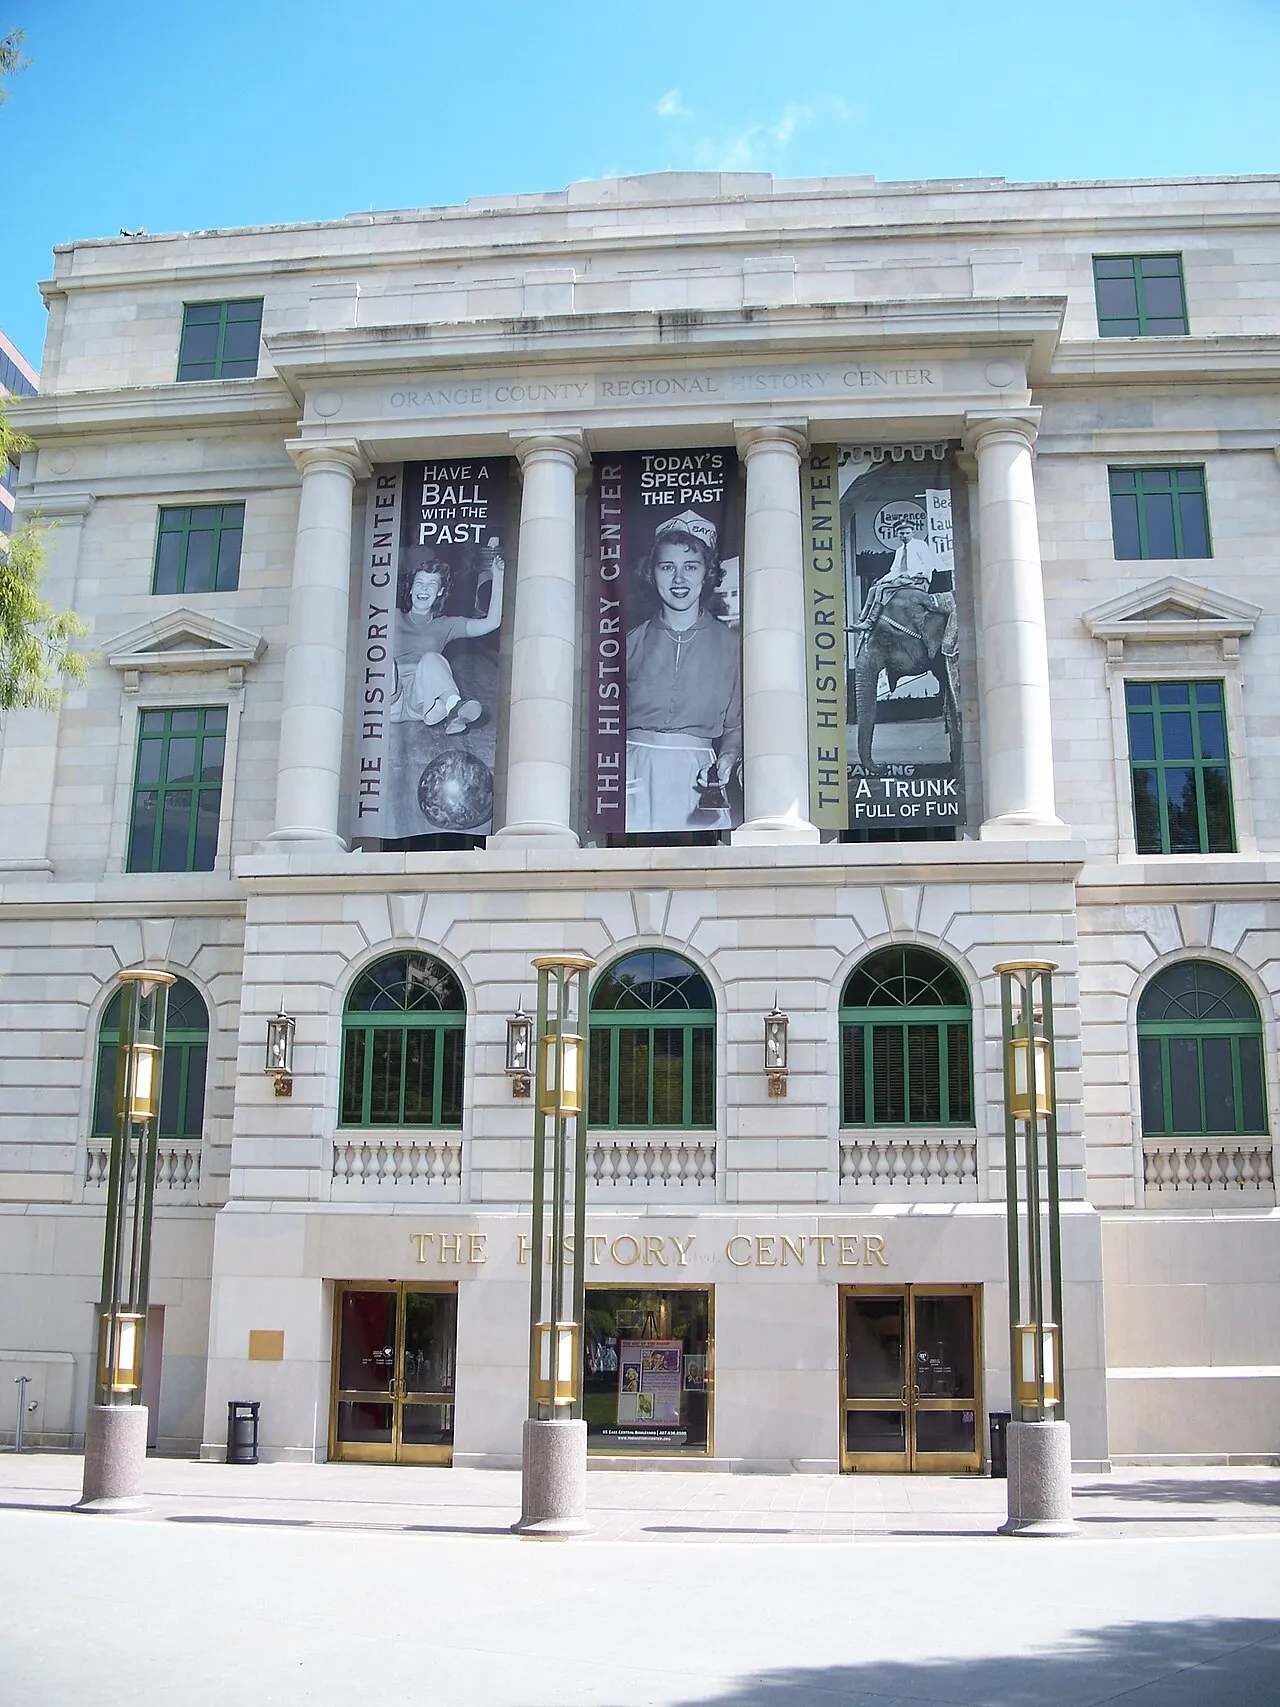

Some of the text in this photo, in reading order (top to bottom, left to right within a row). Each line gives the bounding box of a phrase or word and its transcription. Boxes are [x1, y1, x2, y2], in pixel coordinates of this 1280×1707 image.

[390, 369, 934, 408] ORANGE COUNTY REGIONAL HISTORY CENTER
[641, 453, 723, 472] TODAY'S
[423, 465, 490, 482] HAVE A
[640, 471, 724, 488] SPECIAL:
[421, 484, 488, 506] BALL
[641, 488, 724, 505] THE PAST
[421, 506, 488, 519] WITH THE
[880, 510, 926, 526] Lawrence
[418, 522, 486, 545] PAST
[596, 465, 622, 815] THE HISTORY CENTER
[810, 455, 840, 809] THE HISTORY CENTER
[358, 474, 397, 819] THE HISTORY CENTER
[855, 778, 957, 799] A TRUNK
[855, 801, 959, 818] FULL OF FUN
[410, 1232, 488, 1264] THE
[726, 1234, 889, 1266] CENTER
